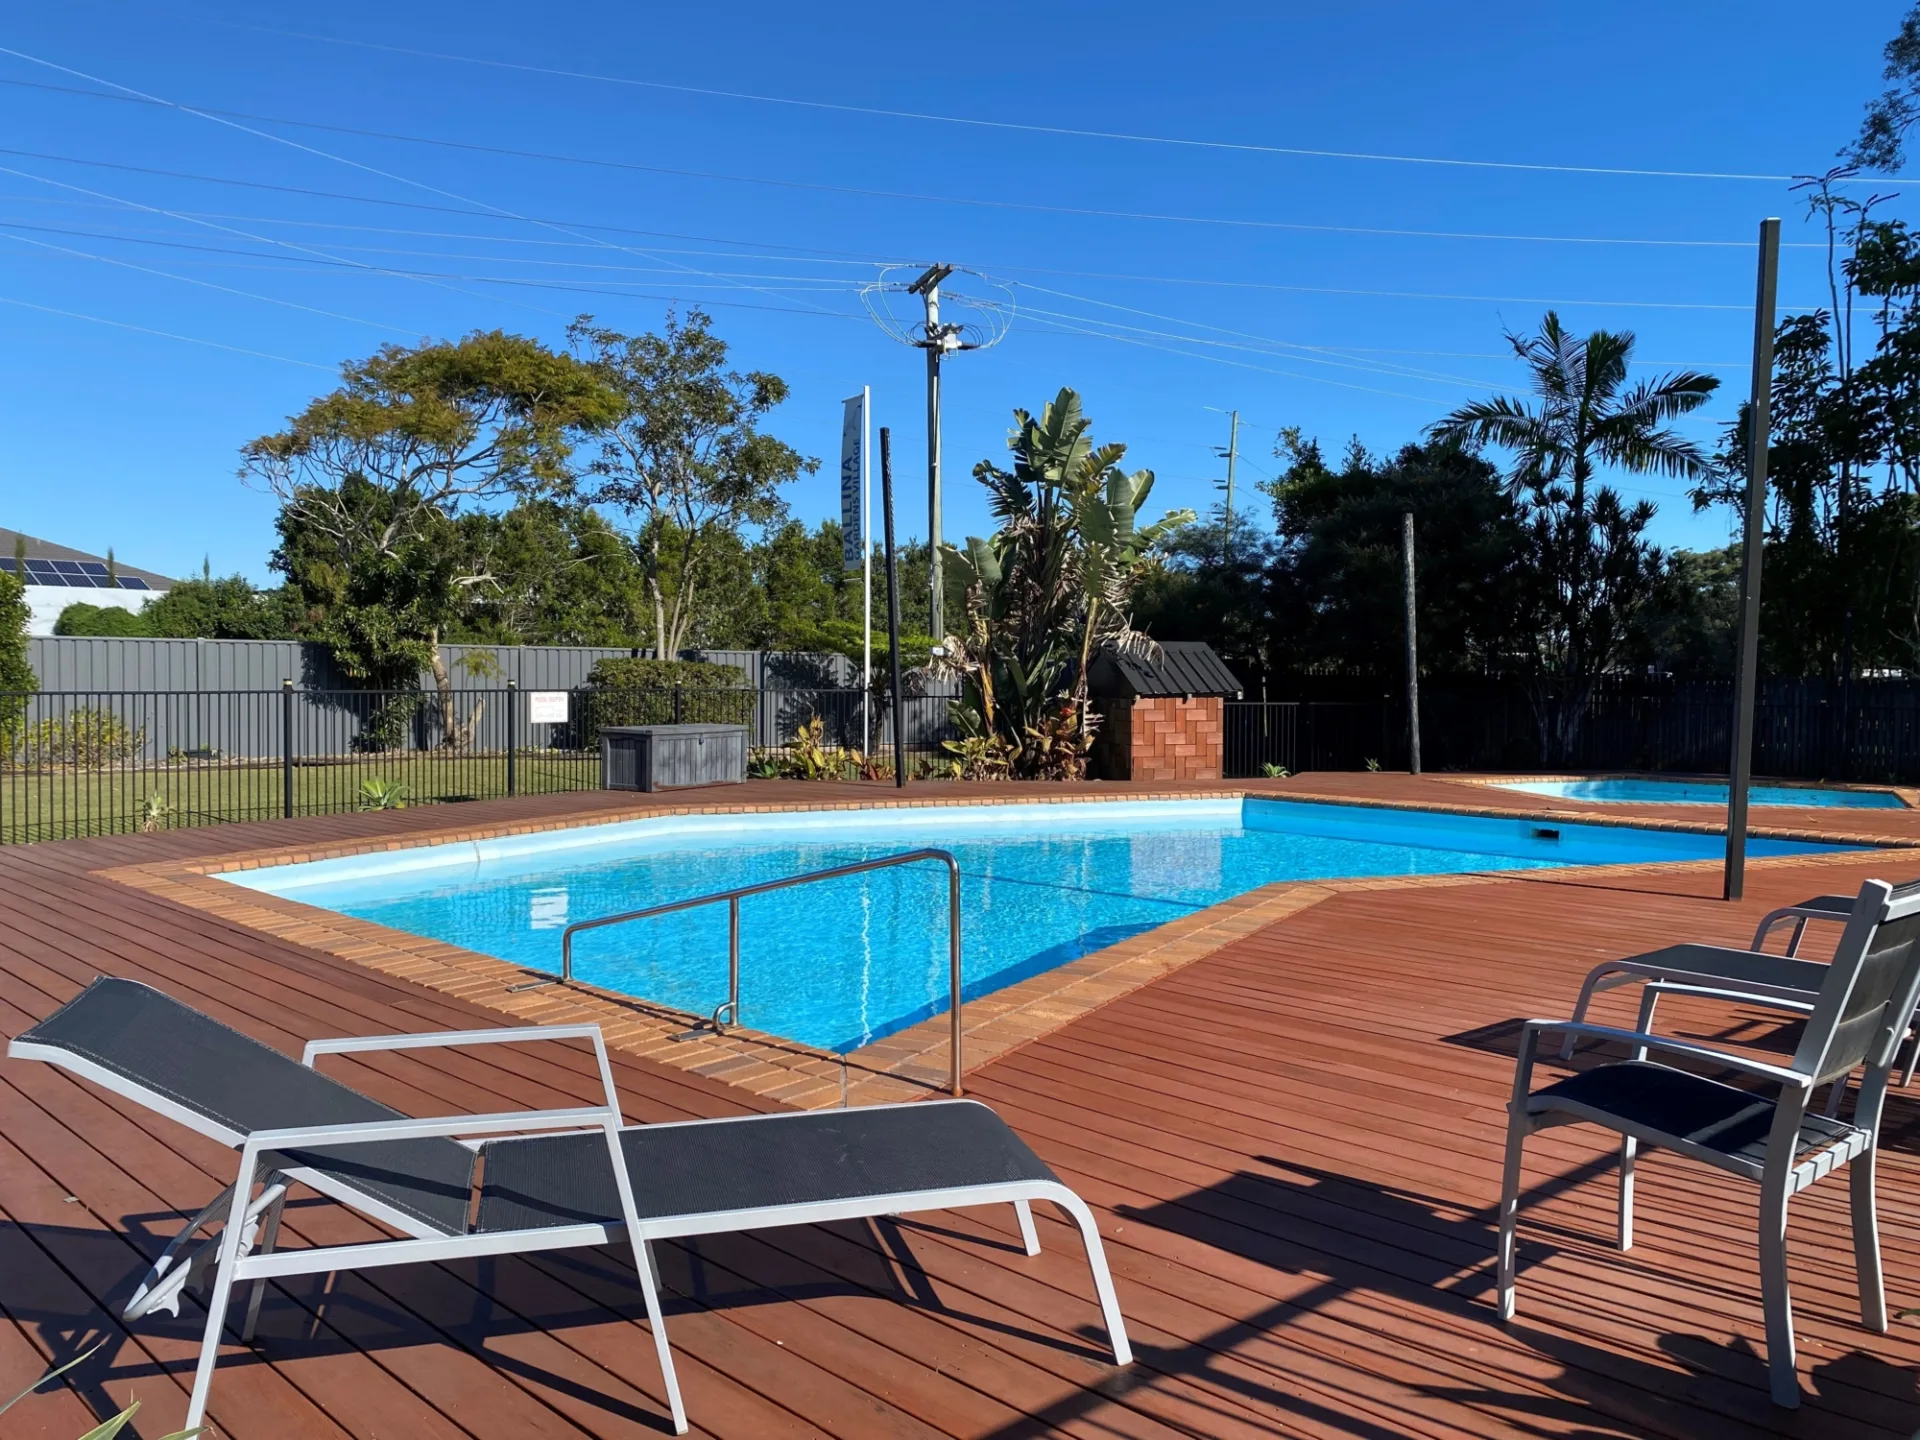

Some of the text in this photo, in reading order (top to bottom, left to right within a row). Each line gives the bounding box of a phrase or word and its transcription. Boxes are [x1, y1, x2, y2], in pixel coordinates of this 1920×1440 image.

[841, 456, 853, 561] BALLINA
[852, 438, 860, 561] GARDENS VILLAGE
